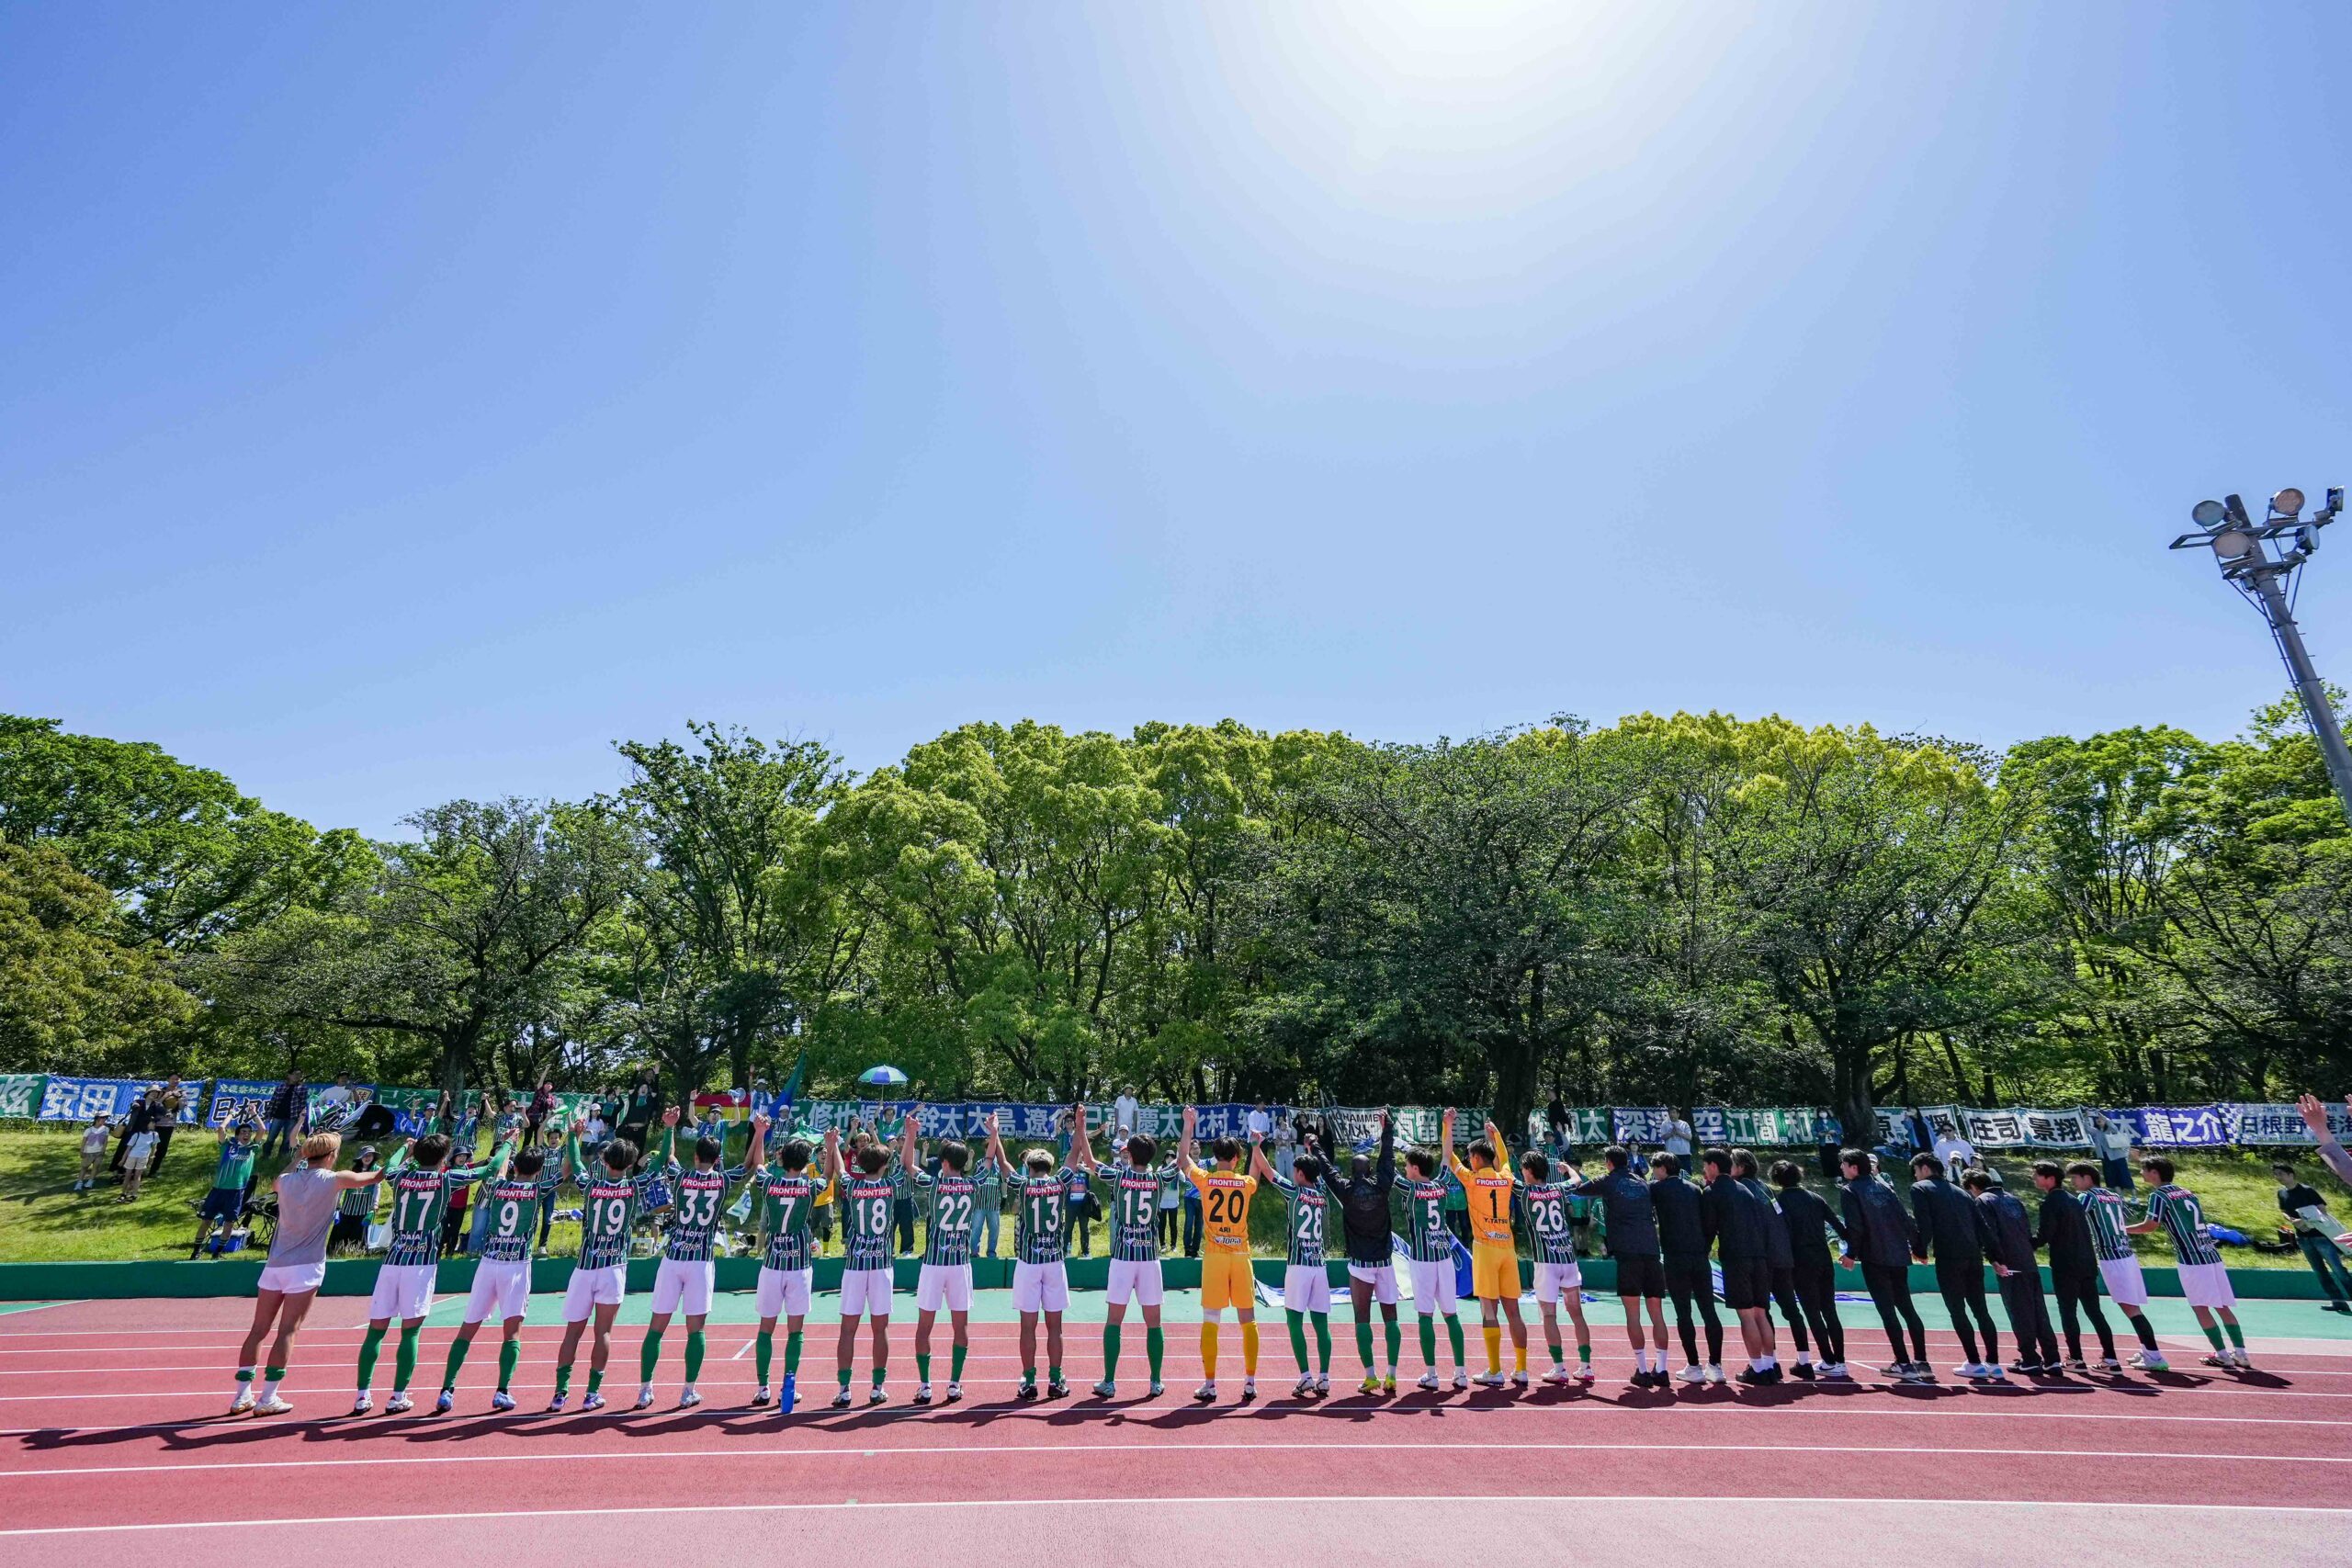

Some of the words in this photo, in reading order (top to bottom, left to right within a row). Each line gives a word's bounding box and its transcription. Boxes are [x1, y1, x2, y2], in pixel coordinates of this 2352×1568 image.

[967, 1106, 1016, 1136] 大島
[1726, 1111, 1779, 1144] 江間
[1969, 1117, 2022, 1141] 庄司
[2028, 1116, 2084, 1142] 景翔
[2143, 1111, 2222, 1143] 龍之介
[2242, 1115, 2307, 1134] 日根野
[400, 1178, 441, 1189] FRONTIER
[496, 1189, 534, 1198] FRONTIER
[592, 1188, 632, 1197] FRONTIER
[683, 1179, 722, 1188] FRONTIER
[854, 1189, 891, 1197] FRONTIER
[1026, 1185, 1062, 1194] FRONTIER
[1121, 1179, 1157, 1189] FRONTIER
[1208, 1179, 1245, 1188] FRONTIER
[1416, 1189, 1445, 1198] FRONTIER
[1476, 1179, 1508, 1187] FRONTIER
[1529, 1190, 1561, 1200] FRONTIER
[399, 1190, 435, 1231] 17
[498, 1201, 519, 1235] 9
[593, 1199, 626, 1235] 19
[680, 1189, 719, 1226] 33
[779, 1197, 796, 1234] 7
[856, 1199, 888, 1235] 18
[938, 1195, 972, 1232] 22
[1031, 1196, 1059, 1234] 13
[1124, 1190, 1152, 1224] 15
[1208, 1188, 1244, 1224] 20
[1427, 1200, 1441, 1230] 5
[1489, 1190, 1498, 1219] 1
[1532, 1201, 1563, 1232] 26
[2105, 1204, 2127, 1235] 14
[2184, 1199, 2205, 1231] 2
[1296, 1205, 1322, 1241] 28
